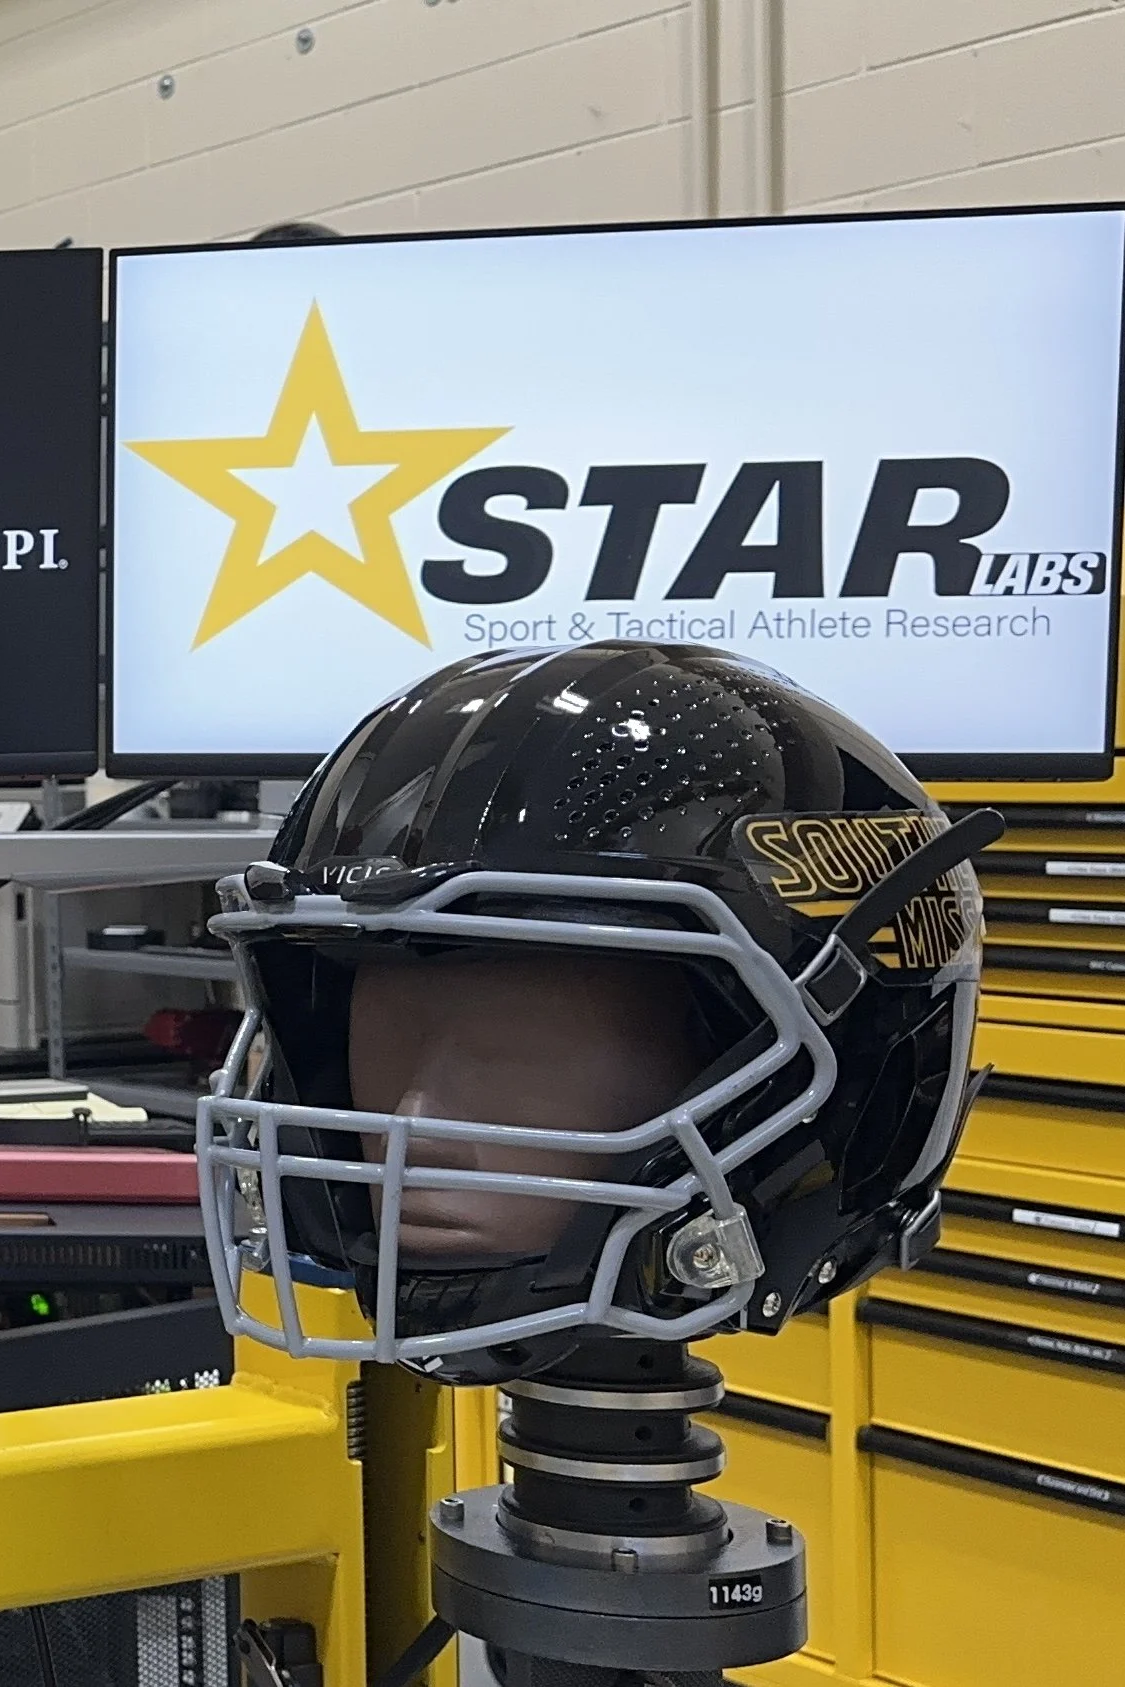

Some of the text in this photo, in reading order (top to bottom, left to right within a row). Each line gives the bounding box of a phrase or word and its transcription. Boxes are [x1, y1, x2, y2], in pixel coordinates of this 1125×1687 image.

[421, 457, 1100, 604] STAR LABS
[464, 606, 1051, 647] Sport & Tactical Athlete Research
